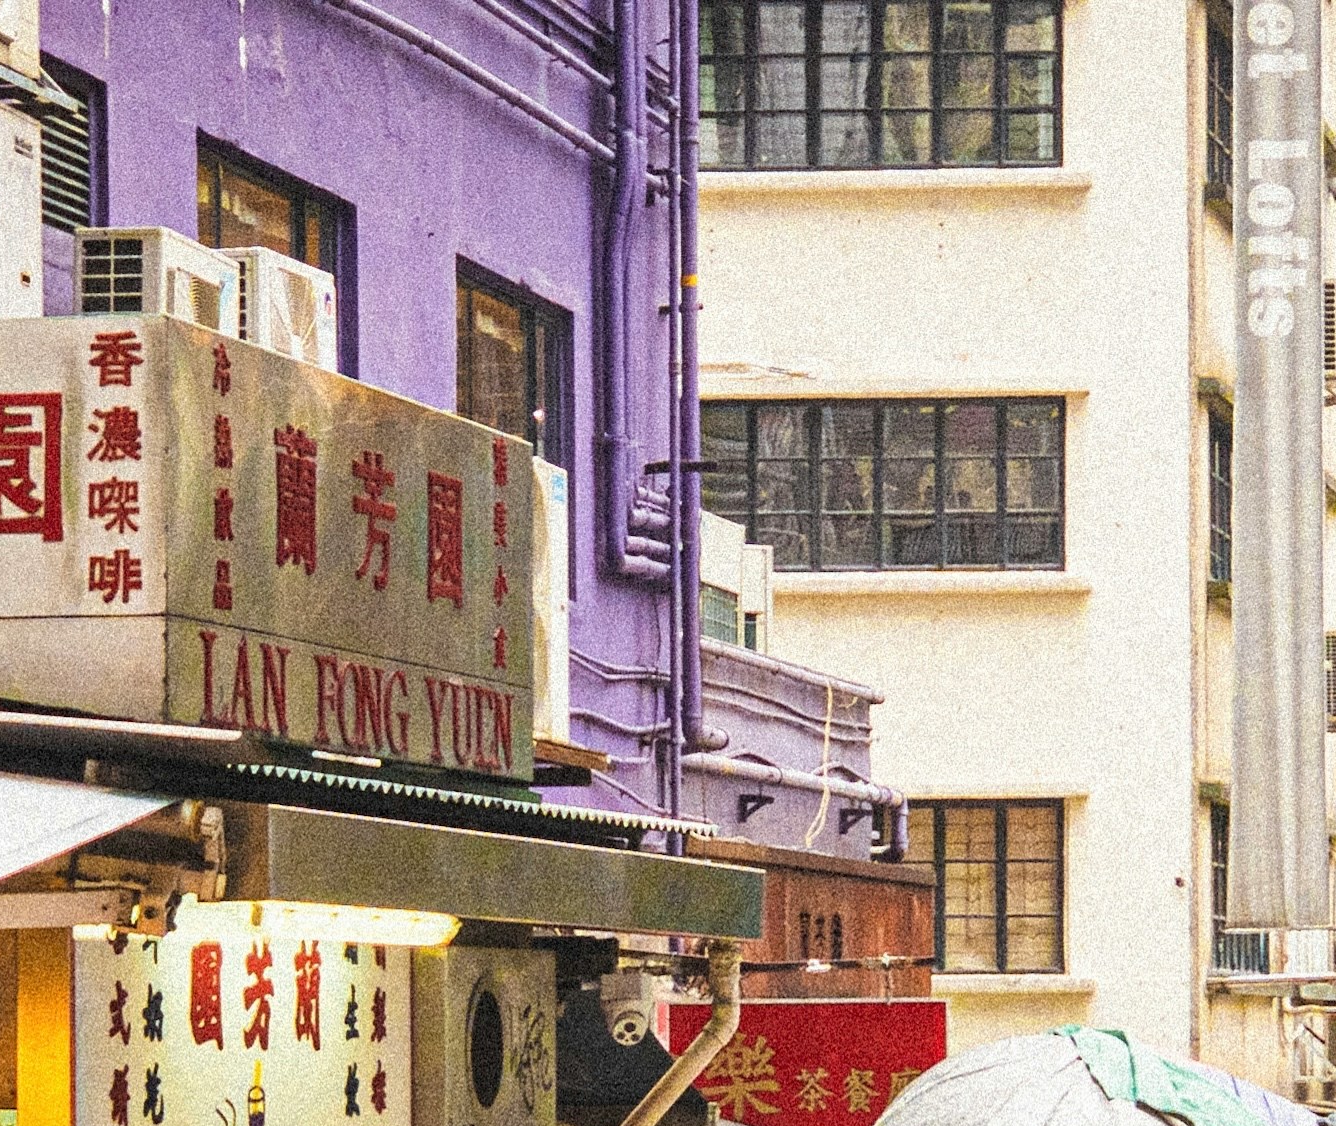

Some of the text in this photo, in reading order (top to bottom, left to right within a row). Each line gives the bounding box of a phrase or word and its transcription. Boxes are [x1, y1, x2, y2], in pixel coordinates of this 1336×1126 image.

[1246, 139, 1310, 339] Lofts
[273, 423, 464, 609] 蘭芳園
[199, 630, 515, 771] LAN FONG YUEN
